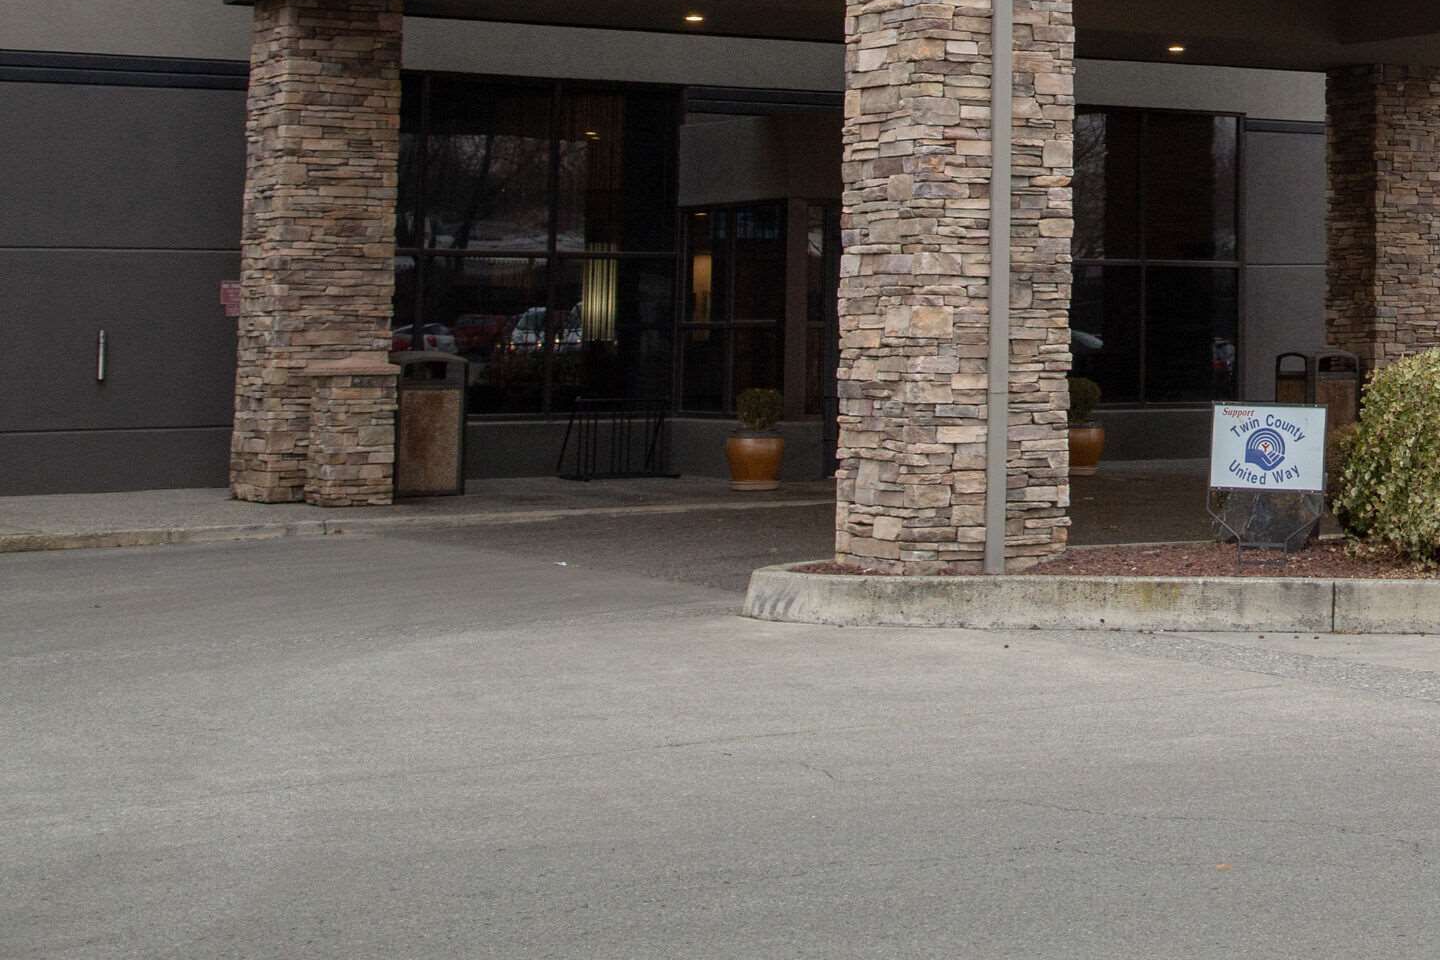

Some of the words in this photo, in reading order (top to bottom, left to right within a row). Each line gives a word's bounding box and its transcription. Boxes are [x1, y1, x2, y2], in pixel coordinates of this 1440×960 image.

[1222, 407, 1254, 418] Support
[1230, 417, 1260, 438] Twin
[1265, 414, 1305, 442] County
[1228, 460, 1266, 485] United
[1272, 464, 1300, 483] Way
